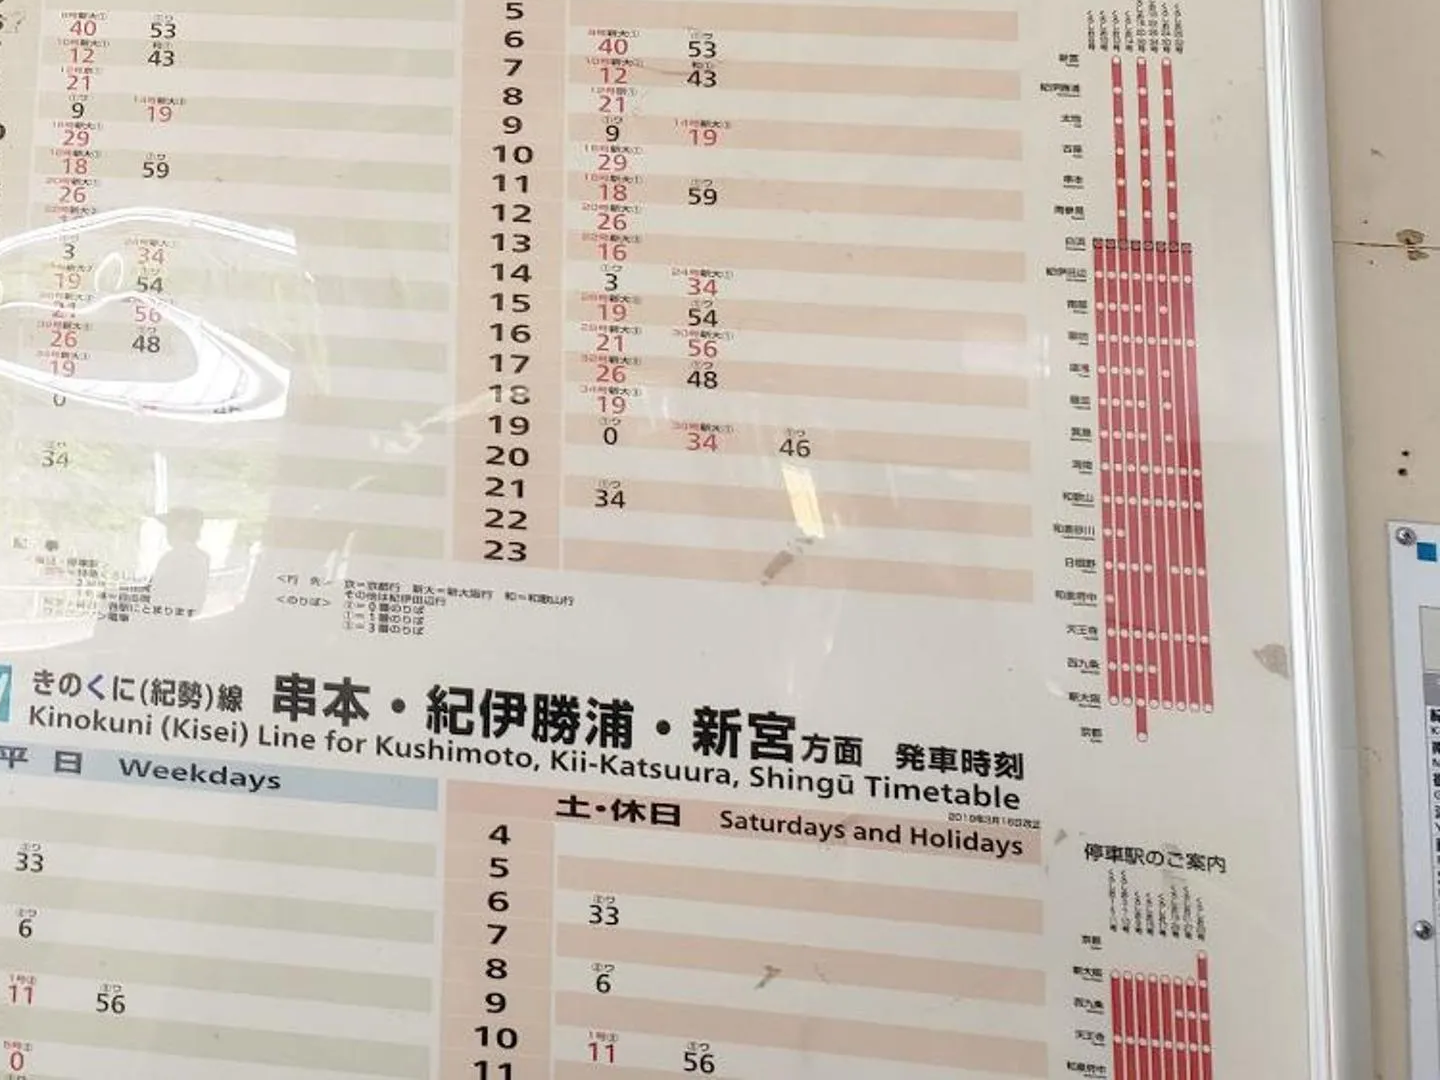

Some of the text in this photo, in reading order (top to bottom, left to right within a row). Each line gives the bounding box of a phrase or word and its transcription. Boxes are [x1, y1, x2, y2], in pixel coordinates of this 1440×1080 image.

[506, 3, 524, 20] 5
[151, 22, 176, 38] 53
[505, 31, 524, 48] 6
[148, 51, 175, 66] 43
[689, 41, 717, 58] 53
[504, 59, 522, 76] 7
[687, 70, 717, 88] 43
[503, 88, 523, 105] 8
[72, 103, 84, 119] 9
[503, 116, 522, 133] 9
[606, 125, 620, 142] 9
[493, 145, 533, 163] 10
[143, 162, 169, 178] 59
[493, 174, 528, 193] 11
[689, 188, 717, 205] 59
[492, 204, 531, 222] 12
[492, 233, 531, 252] 13
[492, 263, 532, 283] 14
[605, 274, 618, 291] 3
[688, 280, 717, 296] 34
[491, 293, 530, 312] 15
[599, 304, 626, 321] 19
[688, 309, 717, 326] 54
[491, 324, 530, 342] 16
[597, 335, 625, 351] 21
[688, 341, 717, 358] 56
[490, 354, 529, 373] 17
[596, 366, 625, 383] 26
[688, 371, 717, 389] 48
[599, 396, 625, 414] 19
[489, 415, 529, 435] 19
[604, 428, 617, 444] 0
[687, 433, 717, 452] 34
[487, 446, 529, 466] 20
[779, 440, 810, 457] 46
[485, 478, 524, 497] 21
[595, 490, 625, 508] 34
[485, 509, 527, 529] 22
[484, 541, 526, 561] 23
[31, 669, 245, 715] きのくに(紀勢)線
[894, 742, 1025, 781] 発車時刻
[28, 704, 154, 736] Kinokuni
[161, 715, 249, 747] (Kisei)
[259, 725, 317, 750] Line
[325, 730, 368, 754] for
[375, 736, 541, 773] Kushimoto,
[550, 749, 740, 789] Kii-Katsuura,
[864, 775, 1021, 811] Timetable
[118, 756, 283, 793] Weekdays
[489, 825, 510, 845] 4
[719, 809, 1024, 857] Saturdays and Holidays
[15, 853, 43, 873] 33
[1083, 842, 1227, 874] 停車駅のご案内
[489, 858, 508, 878] 5
[488, 892, 508, 911] 6
[589, 905, 619, 925] 33
[18, 919, 32, 938] 6
[487, 924, 507, 944] 7
[486, 959, 507, 979] 8
[596, 974, 610, 993] 6
[9, 985, 34, 1005] 11
[96, 993, 125, 1014] 56
[485, 993, 506, 1013] 9
[474, 1026, 517, 1049] 10
[589, 1042, 615, 1063] 11
[684, 1053, 715, 1073] 56
